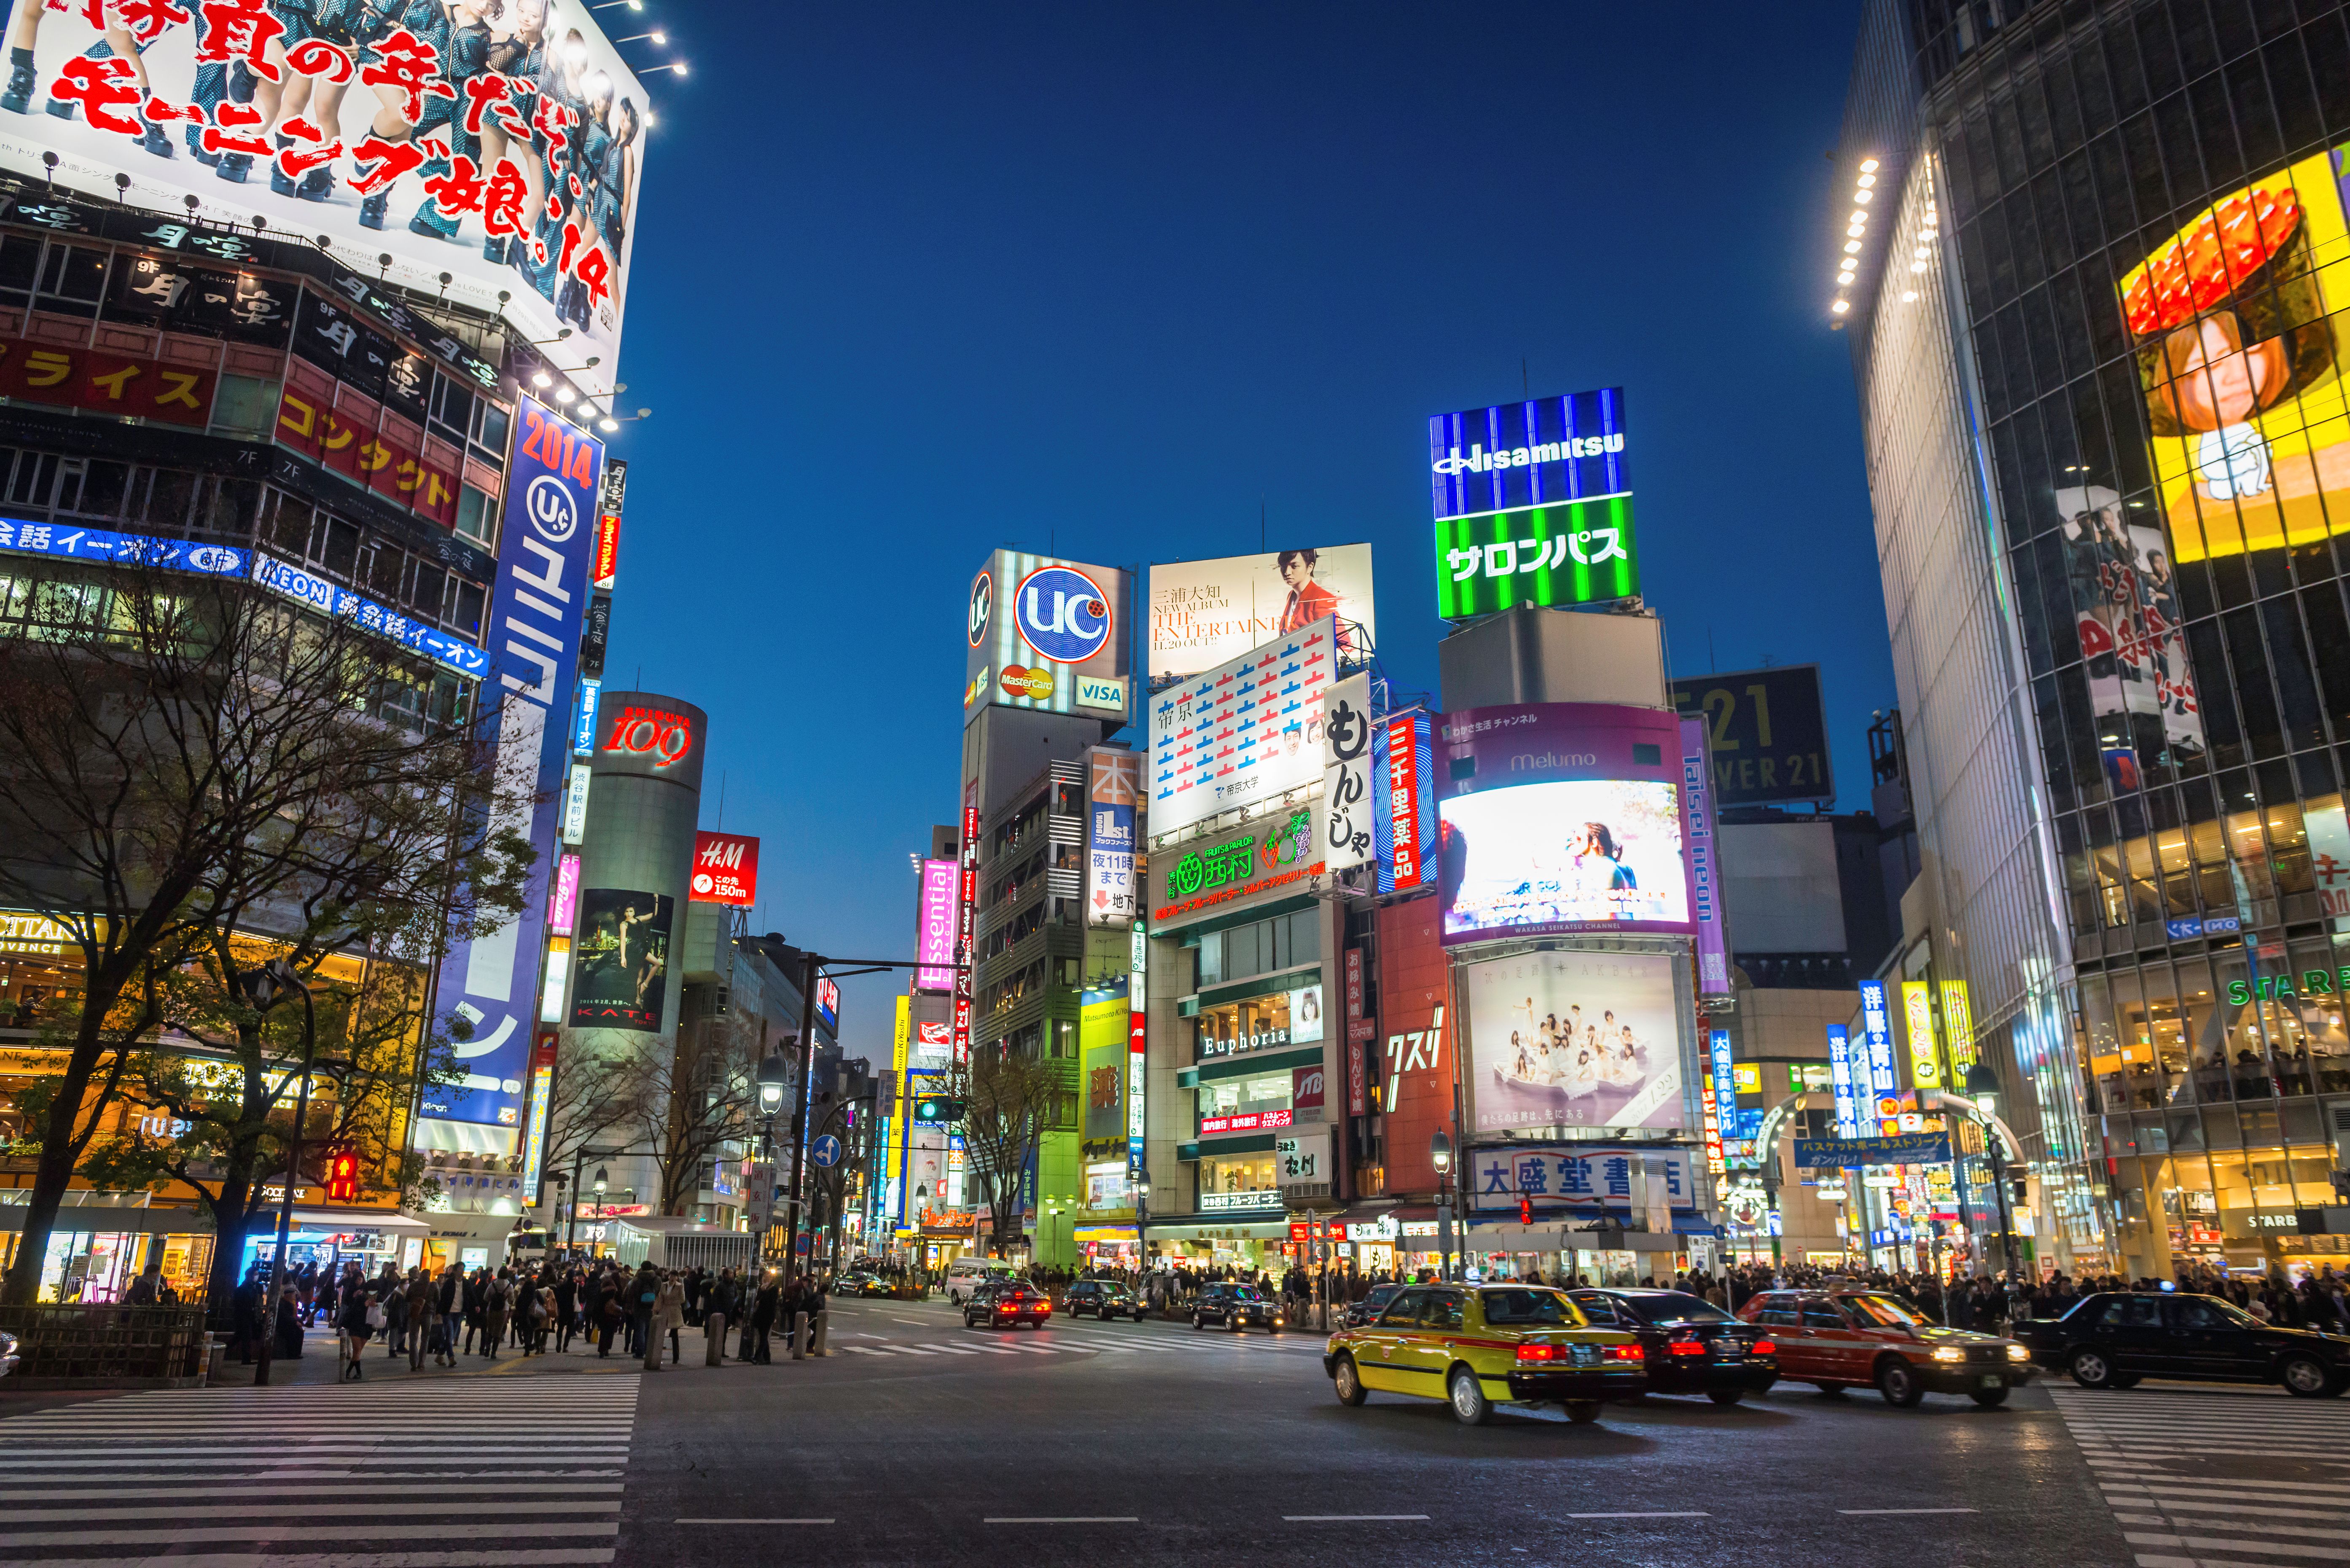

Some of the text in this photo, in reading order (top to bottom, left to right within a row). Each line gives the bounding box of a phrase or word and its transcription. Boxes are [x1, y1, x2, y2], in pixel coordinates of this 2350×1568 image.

[140, 224, 251, 260] 月の宴
[137, 260, 161, 273] 9F
[320, 302, 337, 317] 9F
[0, 344, 200, 409] ライス
[237, 451, 257, 464] 7F
[280, 394, 452, 506] コンタクト
[522, 411, 592, 489] 2014
[281, 461, 299, 477] 7F
[1446, 528, 1627, 582] サロンパス
[1153, 584, 1221, 604] 三浦大知
[1153, 599, 1229, 615] NEW ALBUM
[1153, 611, 1196, 628] THE
[1153, 615, 1297, 642] ENTERTAINER
[1183, 637, 1217, 648] OUT!!
[978, 675, 988, 690] VISA
[1001, 674, 1053, 691] MasterCard
[1082, 683, 1121, 703] VISA
[580, 687, 596, 749] 英会話イーオン
[624, 706, 691, 728] SHIBUYA
[1159, 700, 1192, 730] 帝京
[1452, 714, 1537, 737] わかさ生活 チャンネル
[602, 716, 691, 767] 109
[1092, 754, 1138, 803] 本
[1327, 700, 1370, 858] もんじゃ
[1786, 752, 1820, 785] 21
[1226, 775, 1259, 797] 帝京大学
[1682, 747, 1710, 839] Taisei
[568, 772, 586, 838] 渋谷駅前ビル
[1389, 726, 1414, 879] 三千里薬品
[1095, 837, 1133, 846] ブックファースト
[562, 854, 579, 865] 5F
[701, 840, 745, 870] H&M
[1093, 853, 1133, 870] 夜11時
[715, 876, 739, 885] この先
[1100, 872, 1127, 886] まで
[1167, 848, 1253, 899] 渋谷 西村
[714, 884, 746, 898] 150m
[1691, 846, 1714, 923] neon
[1113, 893, 1135, 910] 地下
[921, 864, 947, 984] Essential
[943, 865, 953, 983] DMAGE-CARE
[1515, 922, 1621, 933] WAKASA SEIKATSU CHANNEL
[1349, 953, 1360, 1016] お好み焼
[1484, 964, 1539, 984] 次の足跡
[823, 977, 838, 1015] LABI
[577, 1008, 656, 1021] KATE
[1084, 1012, 1115, 1023] Matsumoto
[1132, 1028, 1144, 1036] JTB
[1204, 1026, 1286, 1056] Euphoria
[1294, 1028, 1320, 1039] Euphoria
[1863, 985, 1894, 1090] 洋服の青山
[1917, 1064, 1934, 1076] 4F
[884, 1074, 895, 1113] 渋谷駅前
[1089, 1065, 1119, 1109] 薬
[1296, 1071, 1323, 1100] JTB
[1830, 1036, 1857, 1138] 洋服の青山
[1202, 1119, 1227, 1132] 国内旅行
[1231, 1116, 1257, 1128] 海外旅行
[1261, 1117, 1290, 1128] ウエディング
[1263, 1111, 1289, 1120] ハネムーン
[1481, 1108, 1583, 1126] 僕たちの足跡は、先にある
[1802, 1135, 1943, 1152] バスケットボールストリート
[1023, 1169, 1031, 1204] みずほ銀行
[921, 1207, 975, 1227] グルメタウン
